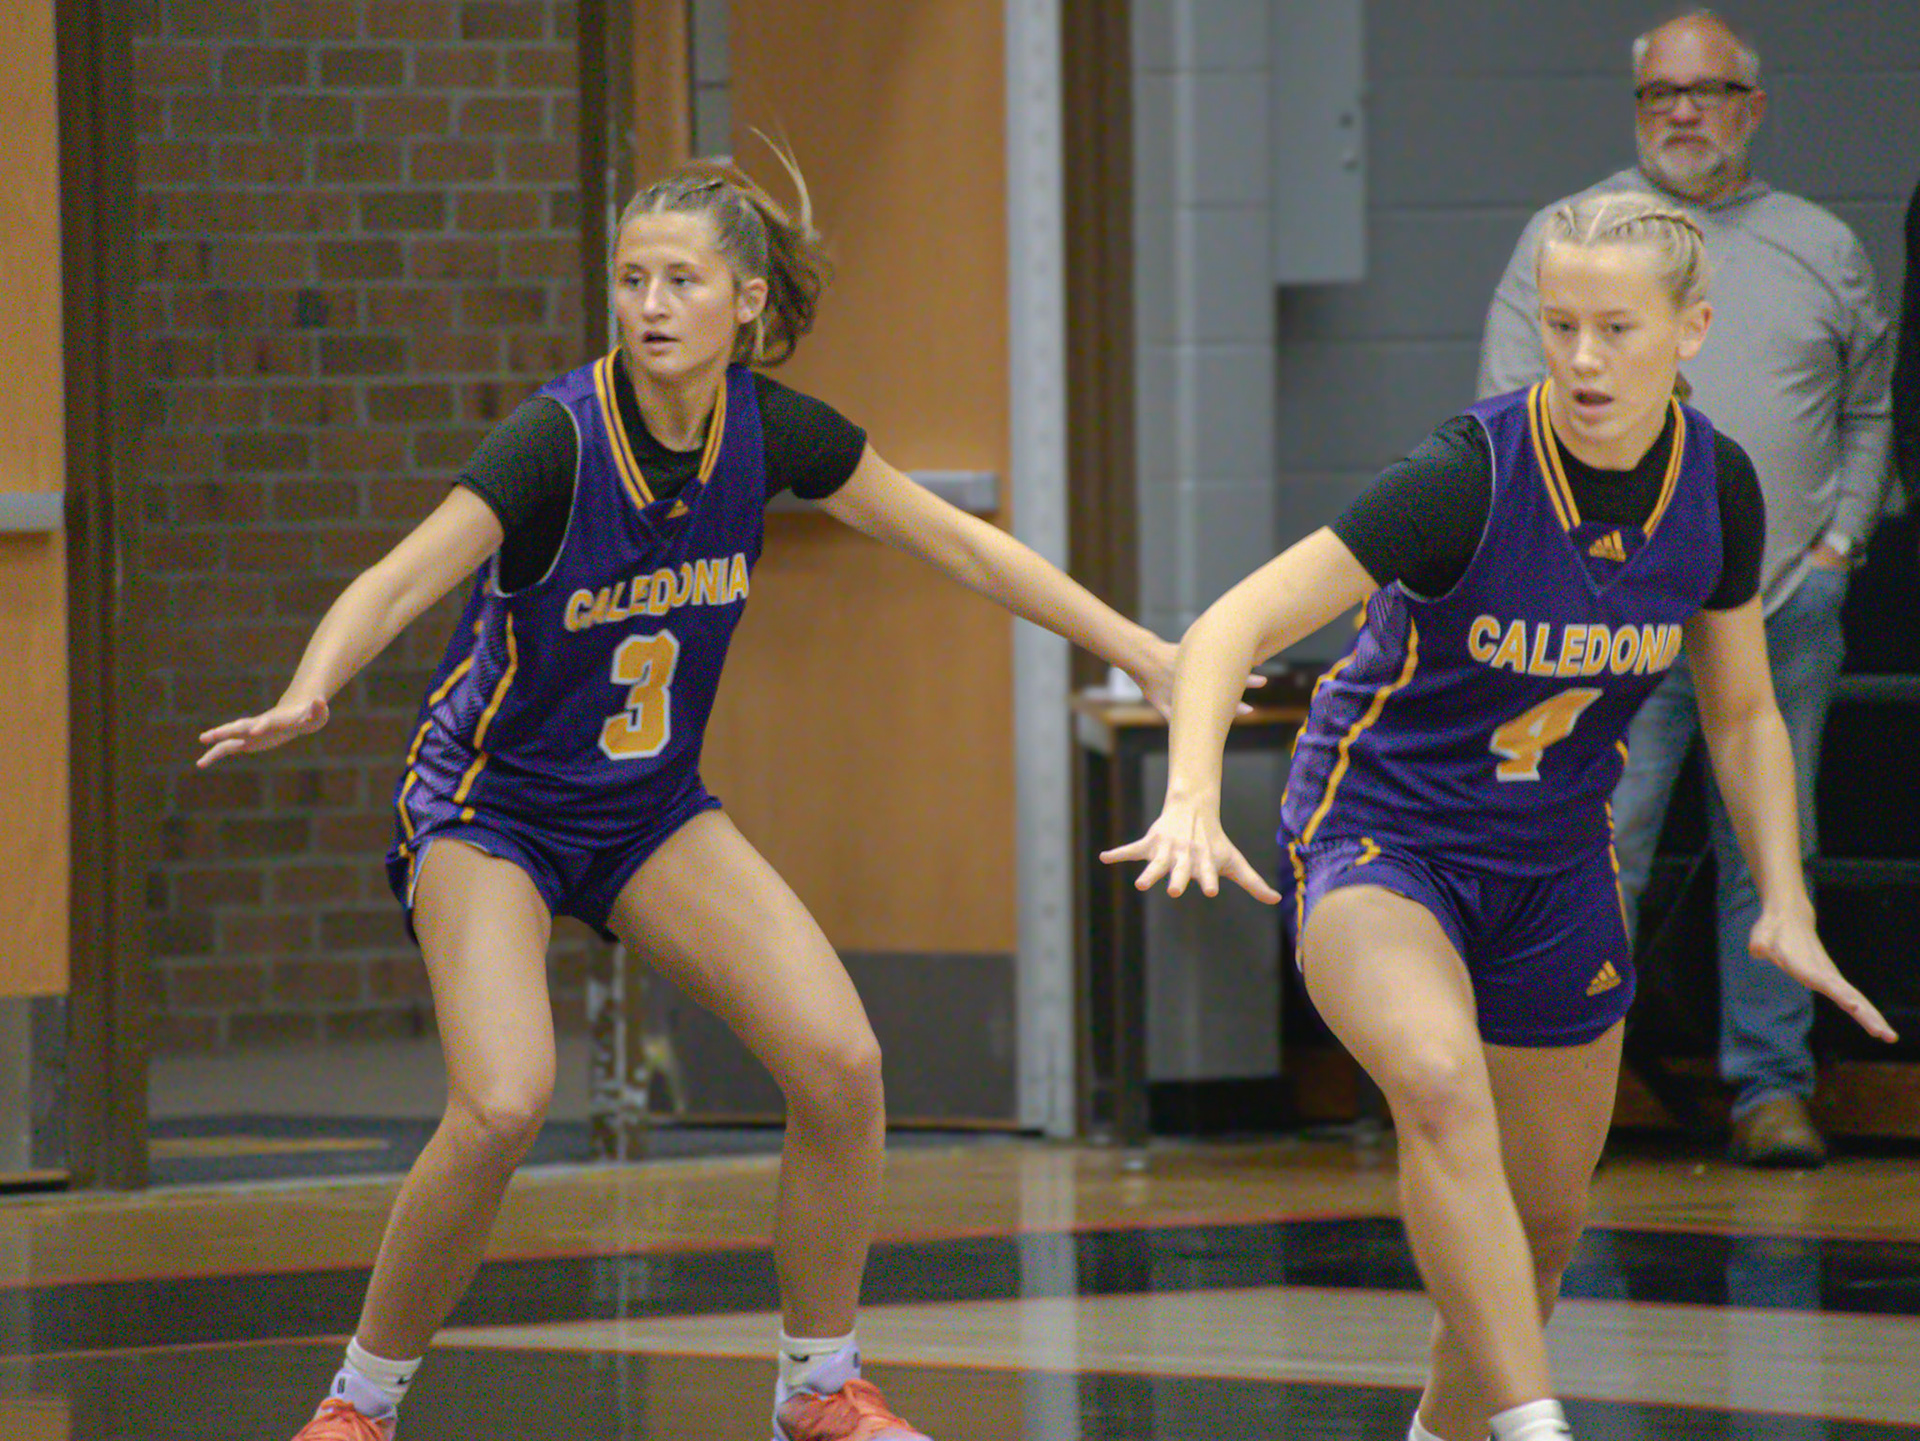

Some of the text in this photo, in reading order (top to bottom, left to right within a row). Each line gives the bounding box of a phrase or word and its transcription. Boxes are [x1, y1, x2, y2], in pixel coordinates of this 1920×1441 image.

[564, 553, 749, 632] CALEDONIA
[599, 629, 680, 760] 3
[1489, 687, 1603, 782] 4
